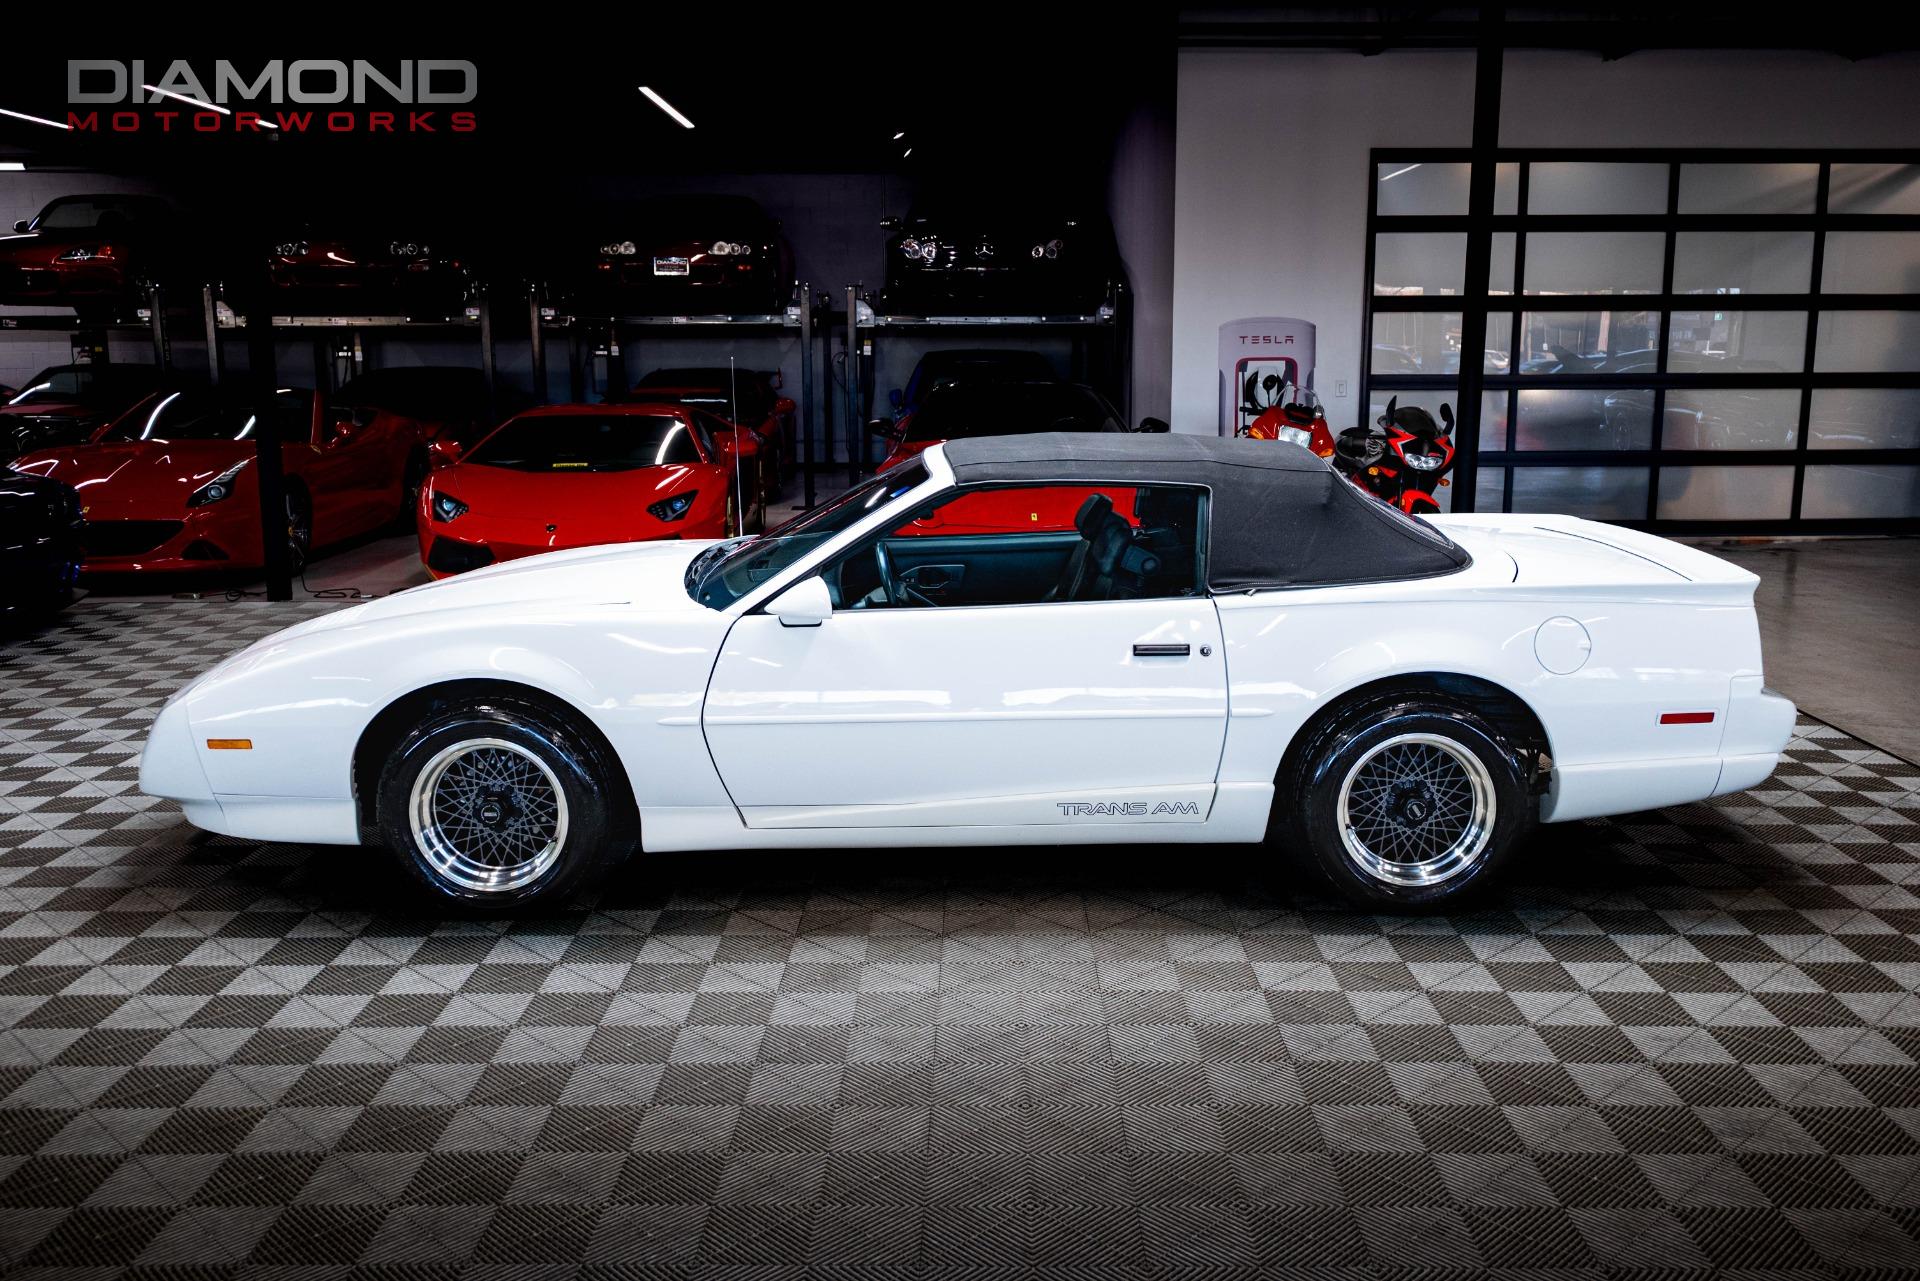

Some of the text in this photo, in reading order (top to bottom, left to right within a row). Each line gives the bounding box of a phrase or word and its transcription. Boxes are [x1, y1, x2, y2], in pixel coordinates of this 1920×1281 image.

[1238, 335, 1294, 345] TESLA
[1057, 801, 1199, 816] TRANS AM
